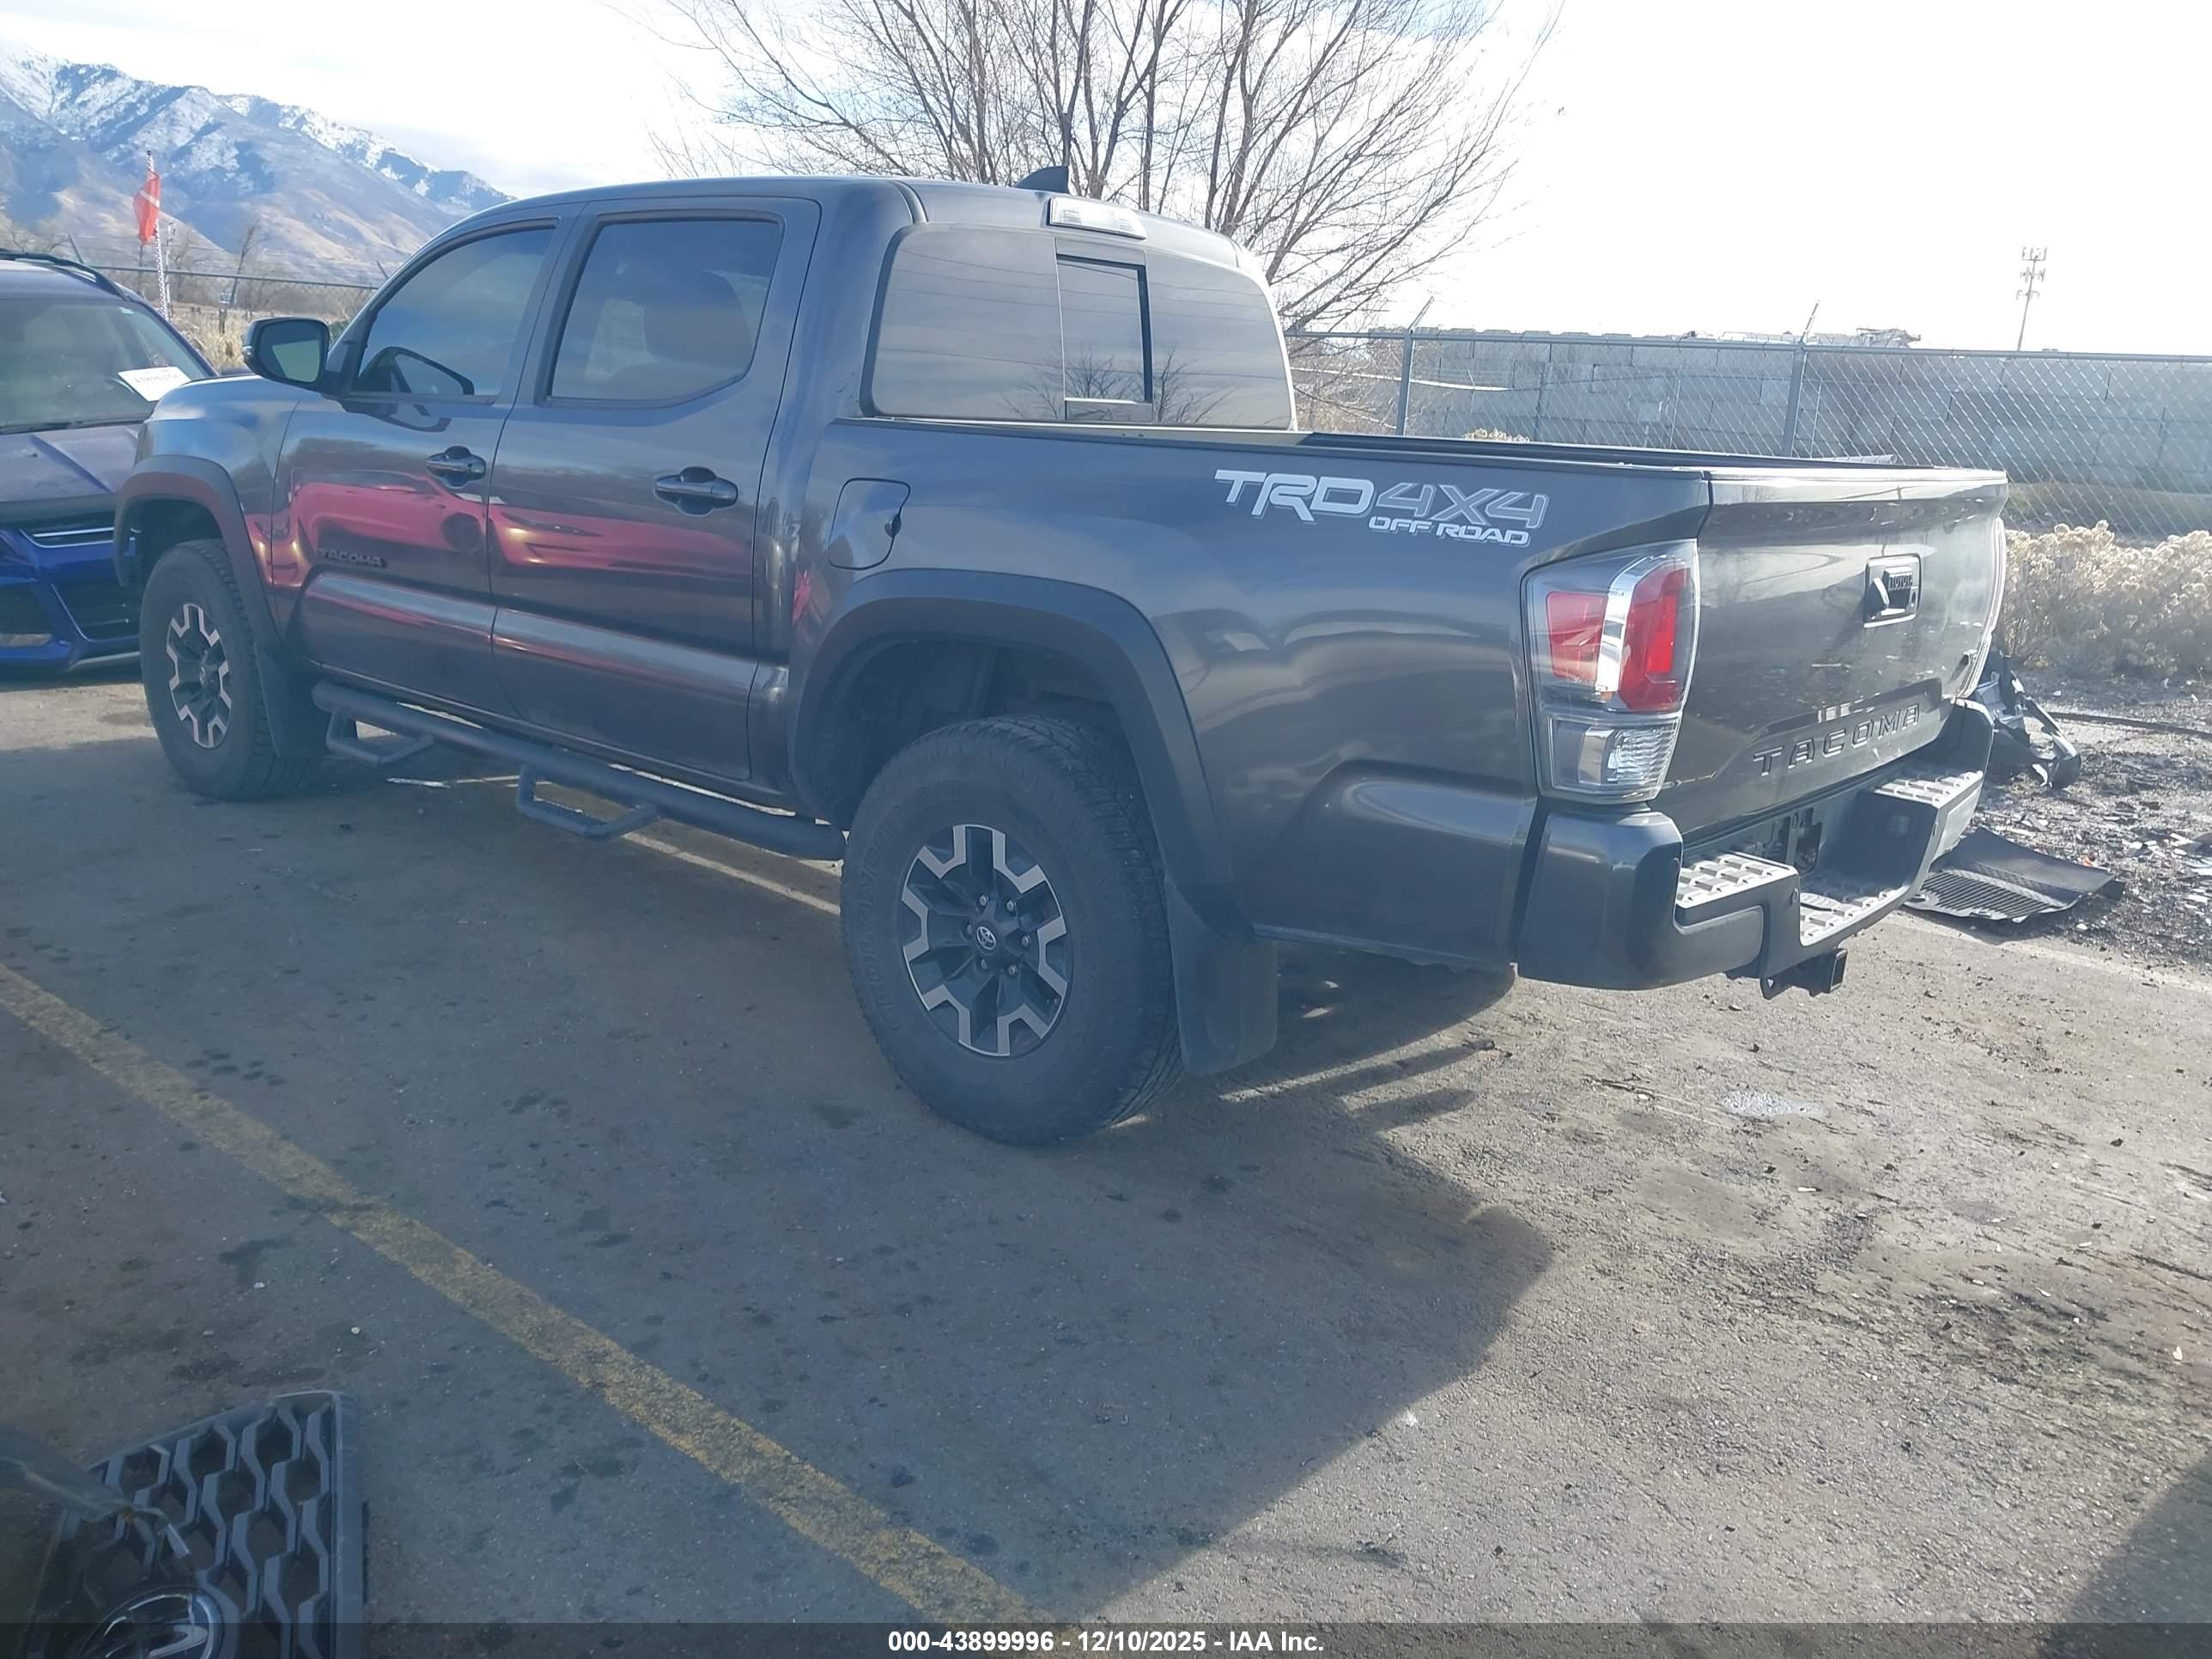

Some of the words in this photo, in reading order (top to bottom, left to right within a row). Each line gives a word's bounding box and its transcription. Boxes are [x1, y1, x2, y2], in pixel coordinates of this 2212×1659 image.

[1213, 468, 1375, 521] TRD
[1375, 482, 1549, 530] 4X4
[1368, 515, 1434, 534] OFF
[1435, 521, 1531, 546] ROAD
[1753, 702, 1920, 776] TACOMA
